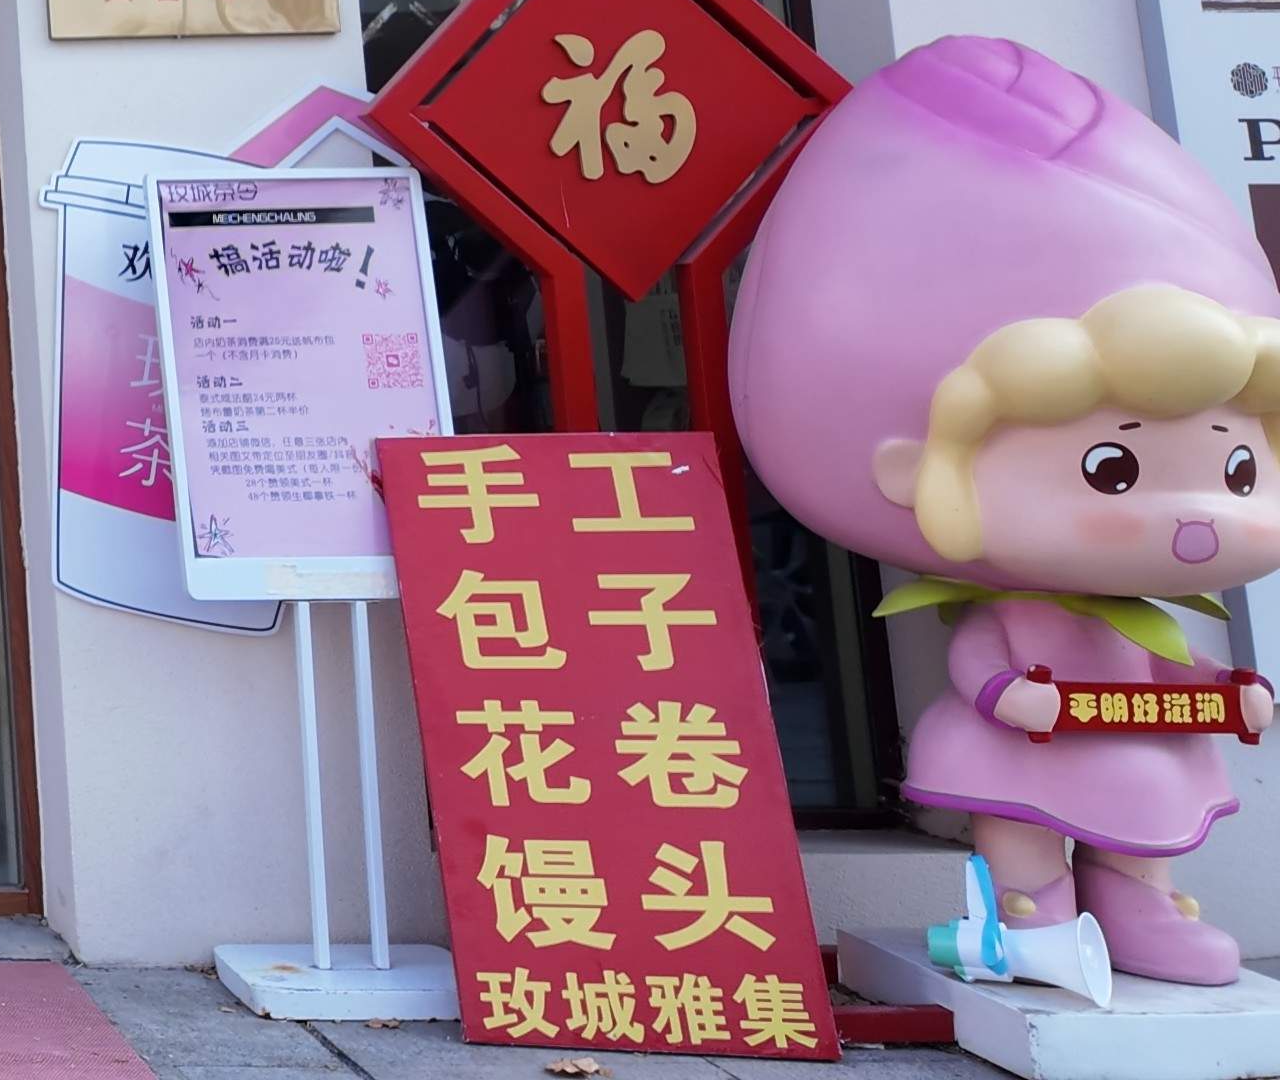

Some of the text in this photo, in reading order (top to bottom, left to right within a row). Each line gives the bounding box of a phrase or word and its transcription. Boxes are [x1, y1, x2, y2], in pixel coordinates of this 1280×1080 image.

[541, 29, 697, 185] 福
[190, 316, 237, 329] 活动一
[196, 375, 243, 389] 活动二
[202, 420, 249, 433] 活动三
[418, 444, 695, 544] 手工
[436, 569, 717, 672] 包子
[456, 699, 749, 808] 花卷
[476, 834, 775, 952] 馒头
[475, 966, 819, 1050] 玫城雅集
